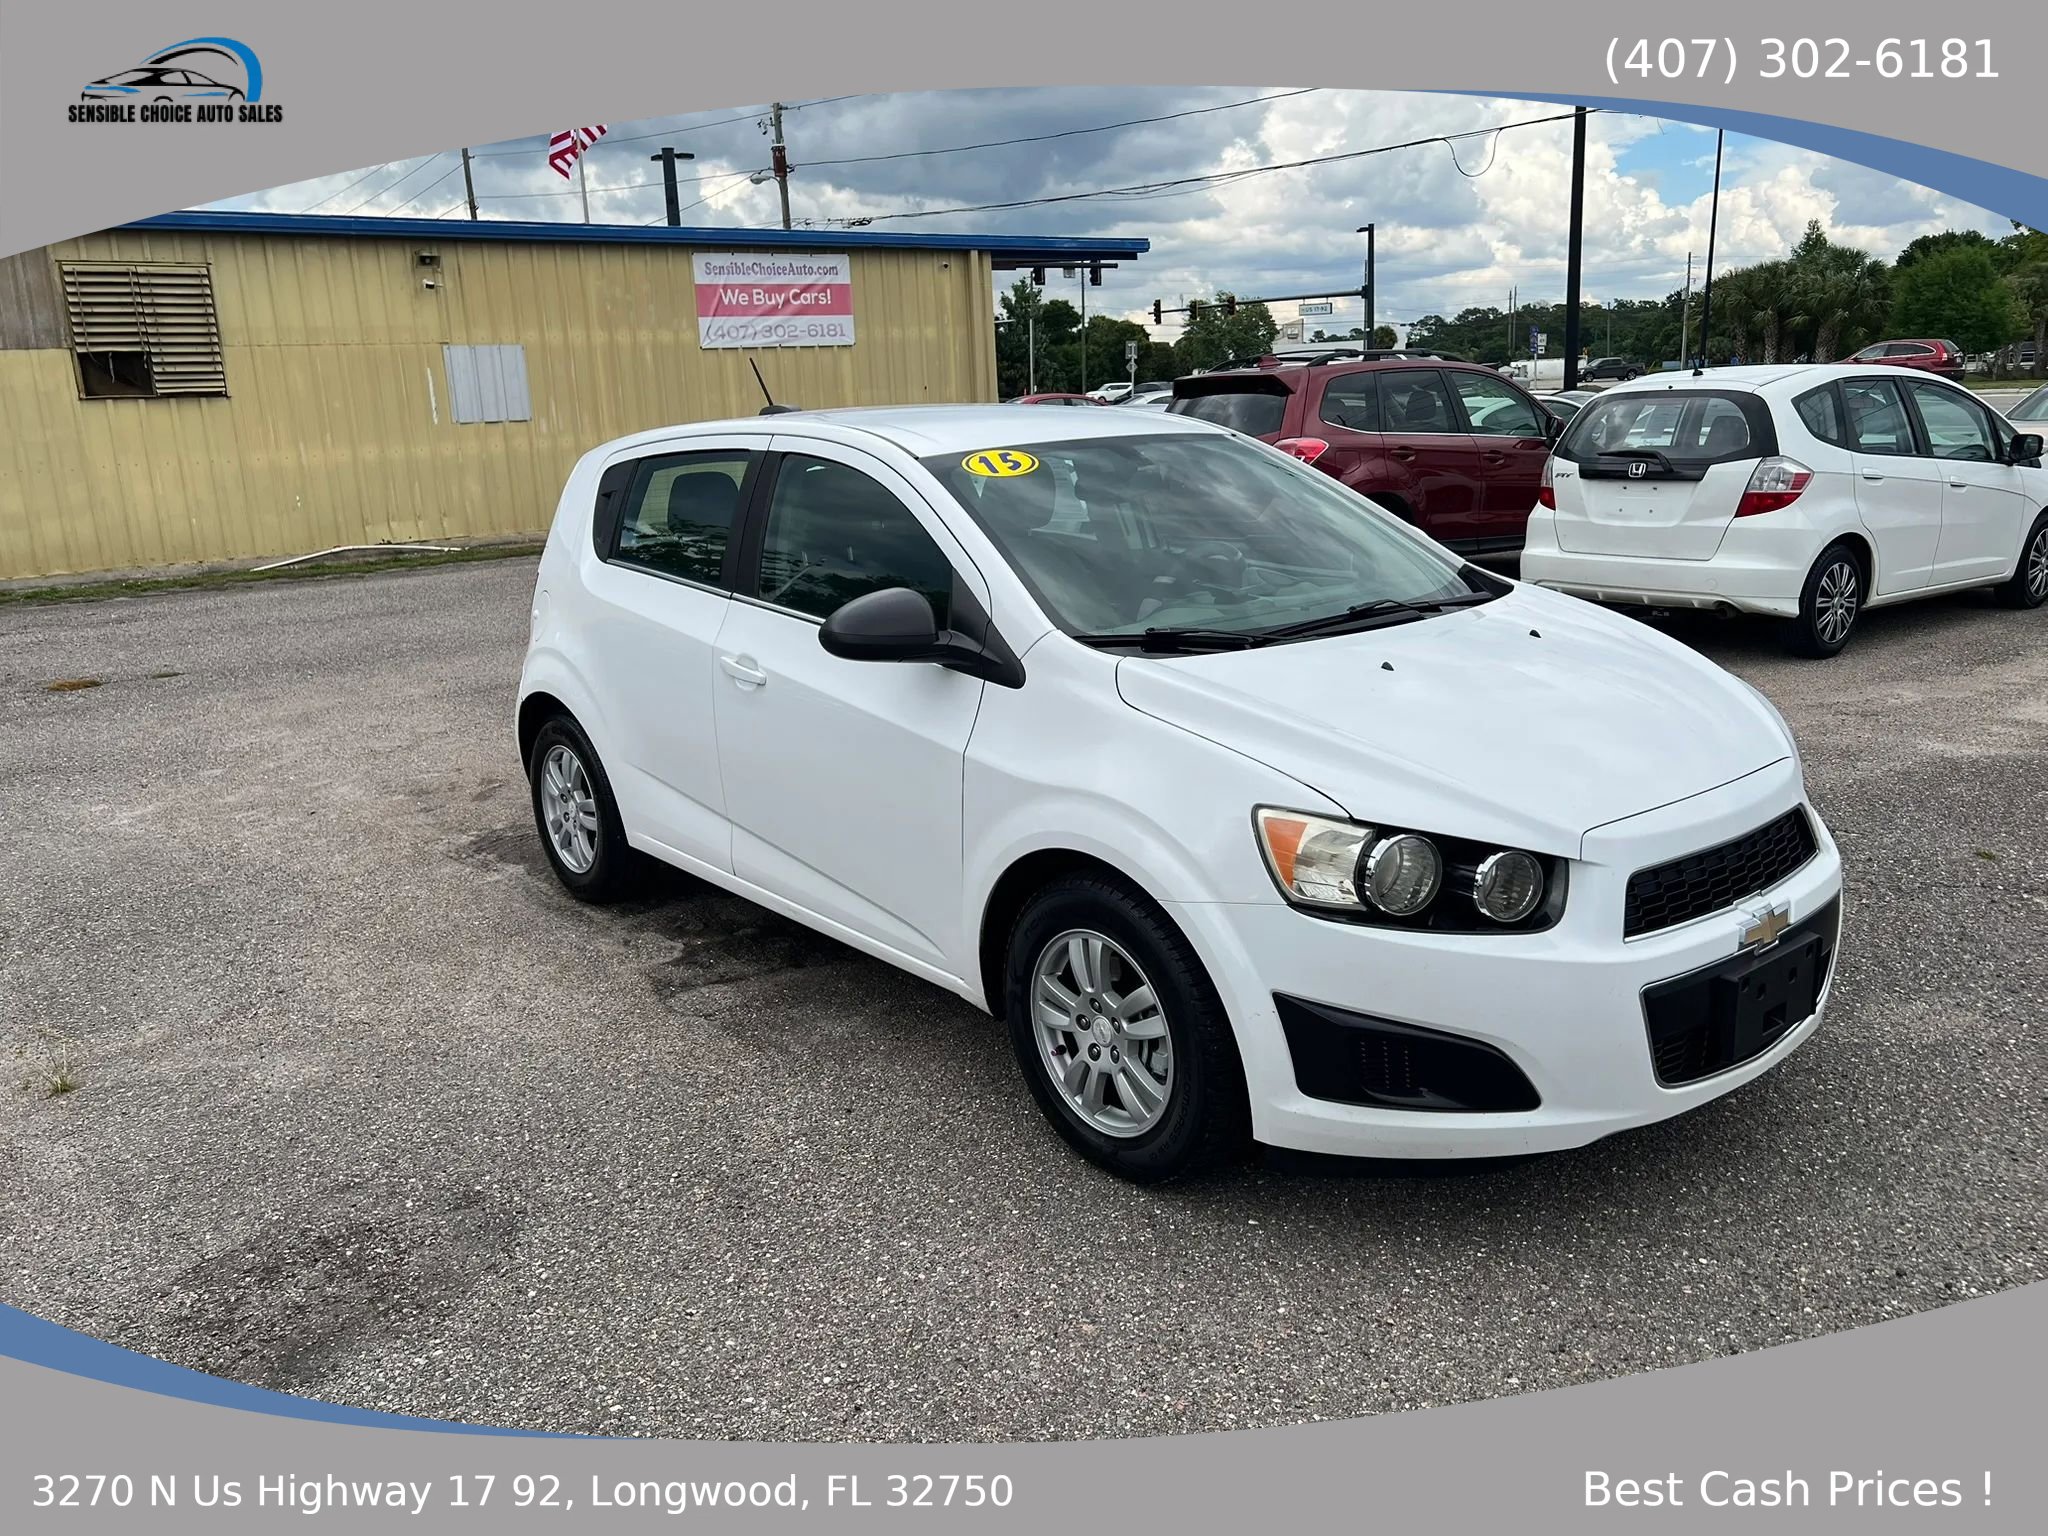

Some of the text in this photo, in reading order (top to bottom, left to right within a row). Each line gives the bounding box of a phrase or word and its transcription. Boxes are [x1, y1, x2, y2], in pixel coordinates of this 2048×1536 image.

[704, 262, 839, 277] SensibleChoiceAuto.com
[720, 288, 832, 309] We Buy Cars!
[706, 323, 846, 341] (407) 302-6181
[978, 452, 1022, 474] 15
